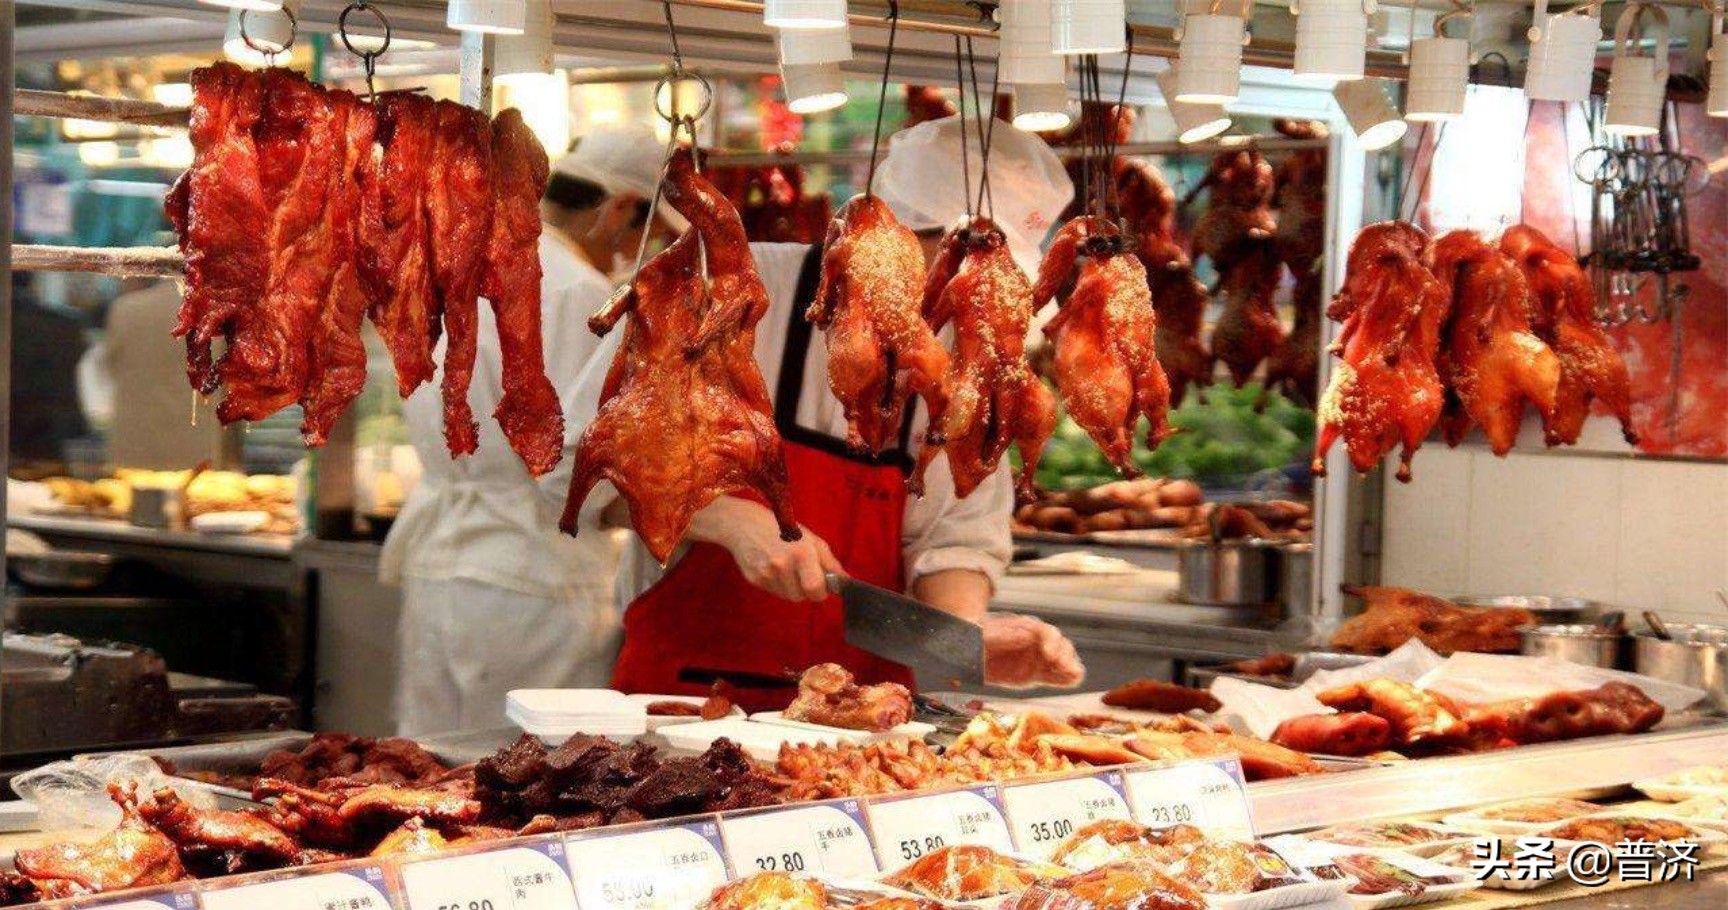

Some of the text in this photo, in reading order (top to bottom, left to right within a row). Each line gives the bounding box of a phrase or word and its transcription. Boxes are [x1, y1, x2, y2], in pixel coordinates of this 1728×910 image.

[1030, 819, 1073, 842] 35.00
[900, 835, 944, 860] 5380
[756, 851, 805, 872] 3280
